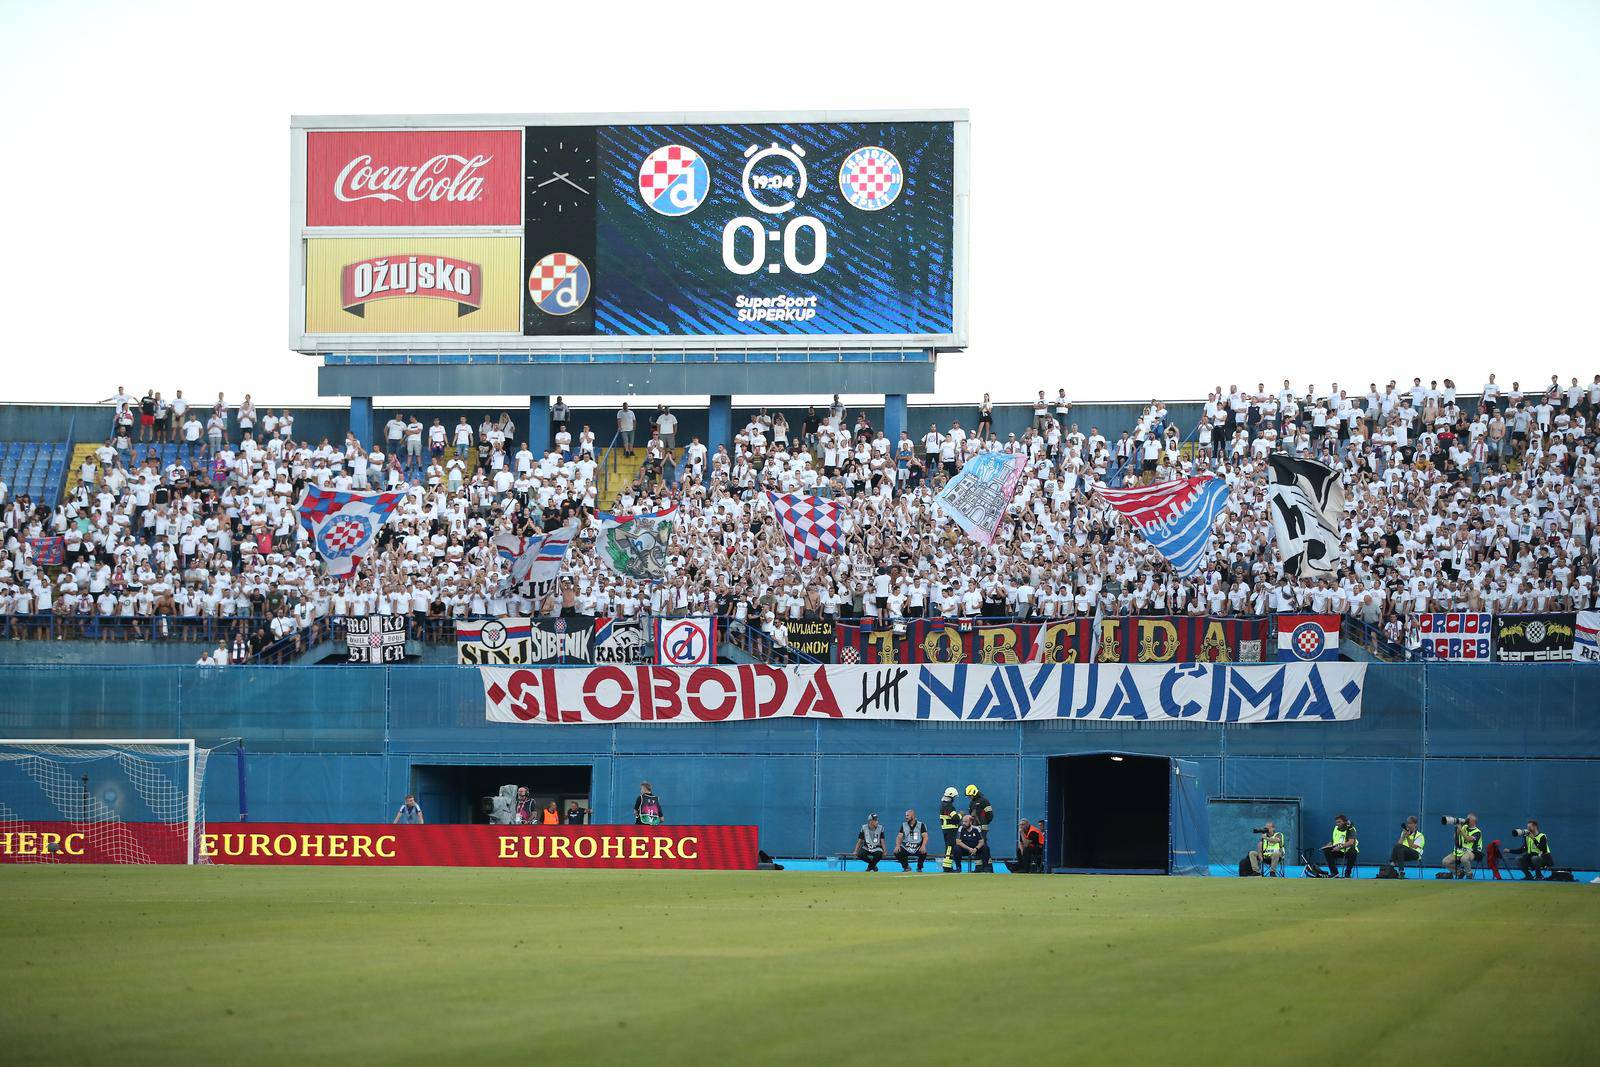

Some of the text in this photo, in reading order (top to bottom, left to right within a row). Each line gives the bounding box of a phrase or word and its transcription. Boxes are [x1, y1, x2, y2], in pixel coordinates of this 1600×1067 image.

[334, 153, 494, 203] Coca-Cola
[752, 175, 795, 190] 19:04
[722, 215, 828, 275] 0:0
[354, 256, 472, 299] Ožujsko
[735, 294, 818, 310] SuperSport
[737, 308, 816, 322] SUPERKUP
[461, 639, 529, 665] SINJ
[531, 621, 595, 665] ŠIBENIK
[868, 619, 1233, 664] TORCIDA
[1420, 638, 1490, 659] AGREB
[1580, 645, 1600, 661] RE
[507, 661, 1337, 722] SLOBODA NAVIJAČIMA
[199, 833, 396, 857] EUROHERC
[498, 836, 698, 859] EUROHERC
